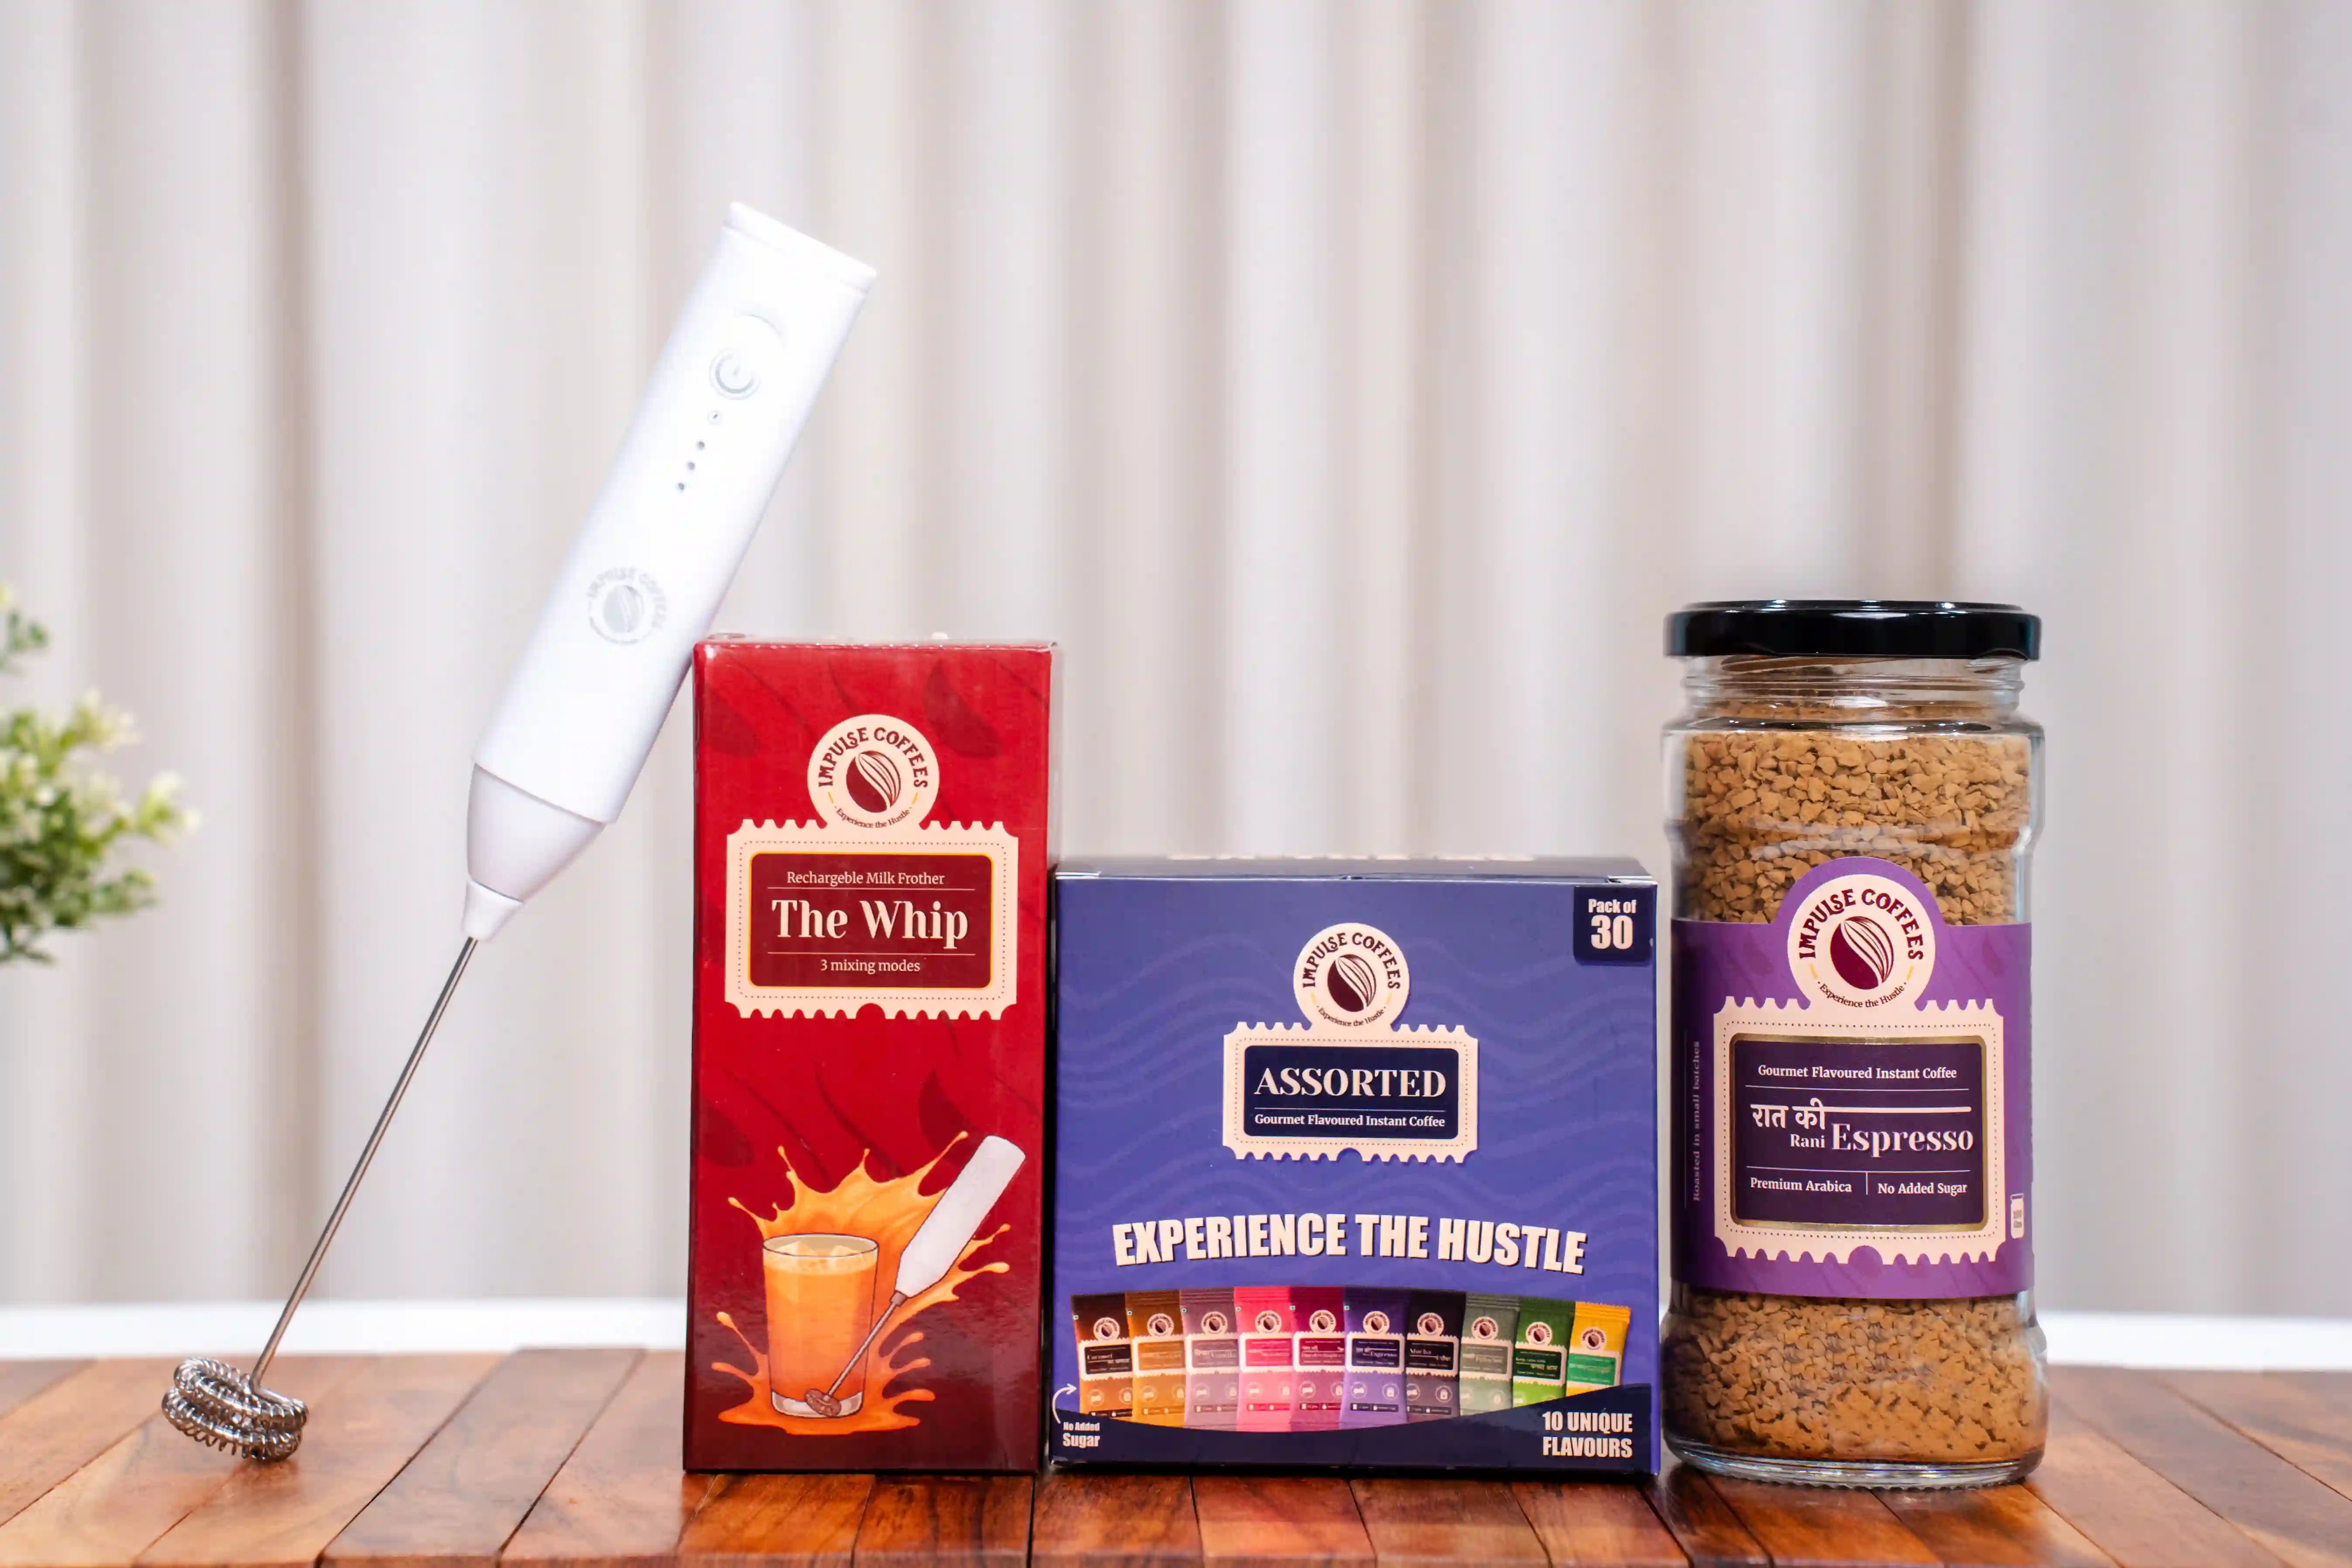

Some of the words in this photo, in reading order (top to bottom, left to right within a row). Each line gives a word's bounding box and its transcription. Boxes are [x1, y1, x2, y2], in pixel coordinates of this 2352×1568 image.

[818, 727, 870, 787] IMPULSE
[873, 727, 928, 788] COFFEES
[836, 808, 873, 829] Experience
[888, 810, 910, 825] Hustle
[787, 871, 863, 887] Rechargeble
[866, 872, 895, 884] Milk
[898, 872, 945, 885] Frother
[1588, 898, 1621, 913] Pack
[1623, 899, 1637, 914] of
[771, 899, 848, 939] The
[859, 900, 968, 949] Whip
[1591, 915, 1633, 949] 30
[1799, 888, 1856, 960] IMPULSE
[1861, 888, 1924, 960] COFFEES
[820, 959, 828, 971] 3
[830, 959, 876, 974] mixing
[878, 959, 921, 972] modes
[1303, 932, 1348, 988] IMPULSE
[1352, 932, 1401, 989] COFFEES
[1819, 983, 1863, 1008] Experience
[1865, 999, 1879, 1008] the
[1881, 985, 1905, 1004] Hustle
[1317, 1007, 1351, 1027] Experience
[1365, 1009, 1385, 1024] Hustle
[1758, 1064, 1808, 1078] Gourmet
[1812, 1066, 1873, 1079] Flavoured
[1876, 1067, 1920, 1079] Instant
[1922, 1067, 1957, 1079] Coffee
[1254, 1068, 1446, 1097] ASSORTED
[1254, 1114, 1305, 1125] Gourmet
[1307, 1114, 1363, 1126] Flavoured
[1365, 1115, 1407, 1126] Instant
[1409, 1115, 1446, 1127] Coffee
[1750, 1104, 1789, 1128] रात
[1792, 1097, 1826, 1130] की
[1692, 1134, 1700, 1147] in
[1790, 1134, 1825, 1148] Rani
[1831, 1122, 1974, 1158] Espresso
[1750, 1177, 1802, 1191] Premium
[1805, 1180, 1852, 1193] Arabica
[1877, 1183, 1895, 1194] No
[1898, 1182, 1934, 1195] Added
[1937, 1182, 1968, 1197] Sugar
[1112, 1212, 1348, 1267] EXPERIENCE
[1355, 1214, 1430, 1259] THE
[1437, 1218, 1589, 1276] HUSTLE
[1063, 1422, 1074, 1431] No
[1075, 1422, 1100, 1431] Added
[1542, 1411, 1563, 1431] 10
[1567, 1411, 1633, 1434] UNIQUE
[1063, 1433, 1100, 1449] Sugar
[1542, 1436, 1633, 1458] FLAVOURS
